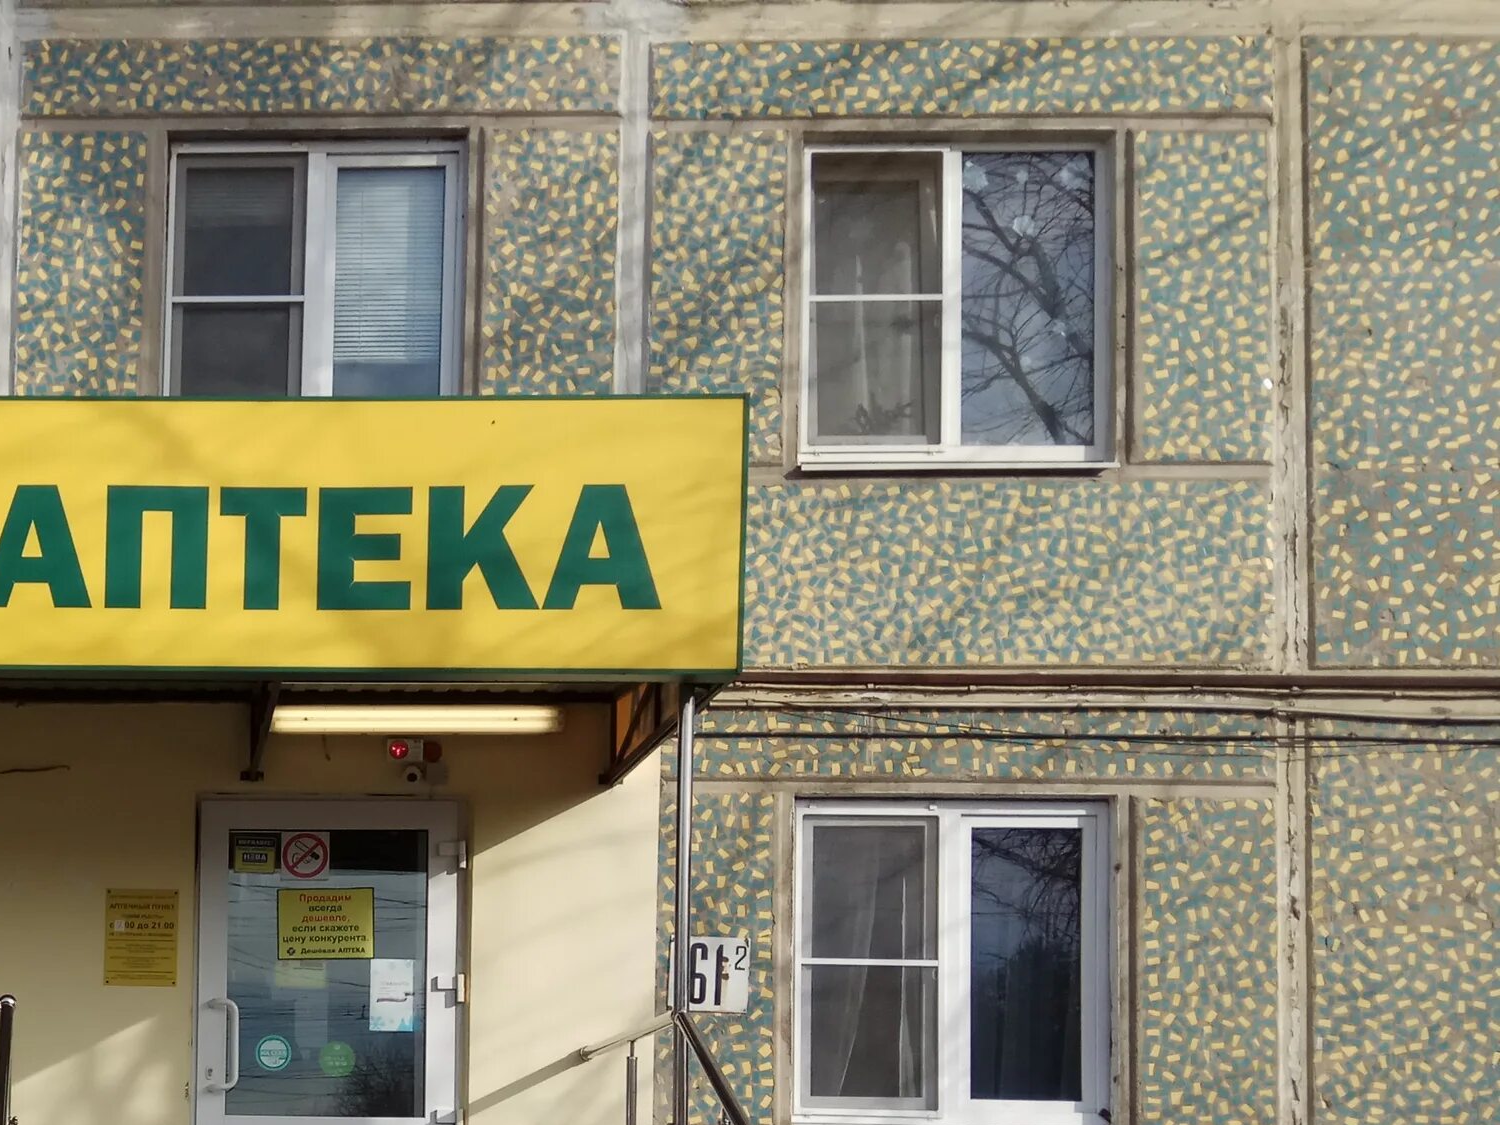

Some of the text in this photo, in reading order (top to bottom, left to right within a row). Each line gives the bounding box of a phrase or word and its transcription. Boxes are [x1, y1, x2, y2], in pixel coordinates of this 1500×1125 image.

[299, 893, 351, 904] Продадим
[319, 924, 360, 932] скажете
[282, 935, 306, 943] цену
